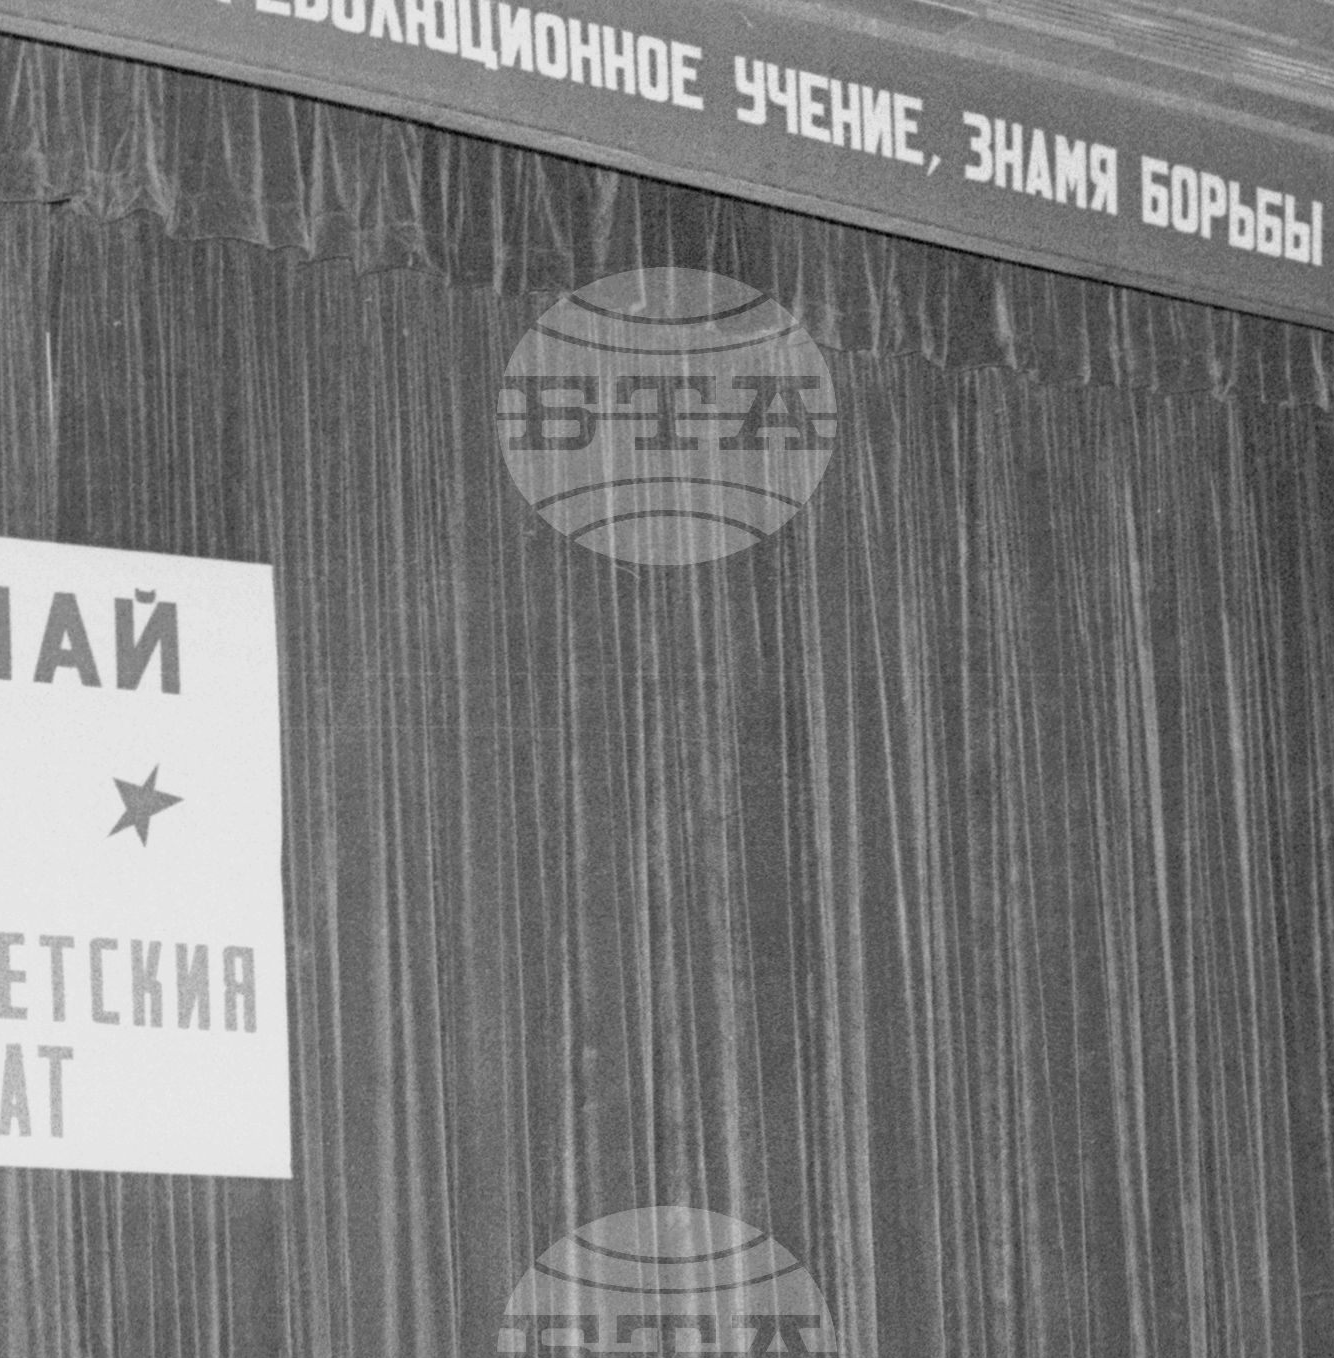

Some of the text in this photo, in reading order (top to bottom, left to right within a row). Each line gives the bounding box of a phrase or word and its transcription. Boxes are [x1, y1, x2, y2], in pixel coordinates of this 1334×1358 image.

[220, 0, 704, 110] ОЛЮЦИОННОЕ
[734, 55, 942, 176] УЧЕНИЕ,
[964, 112, 1118, 215] ЗНАМЯ
[1142, 156, 1323, 266] БОРЬБЫ
